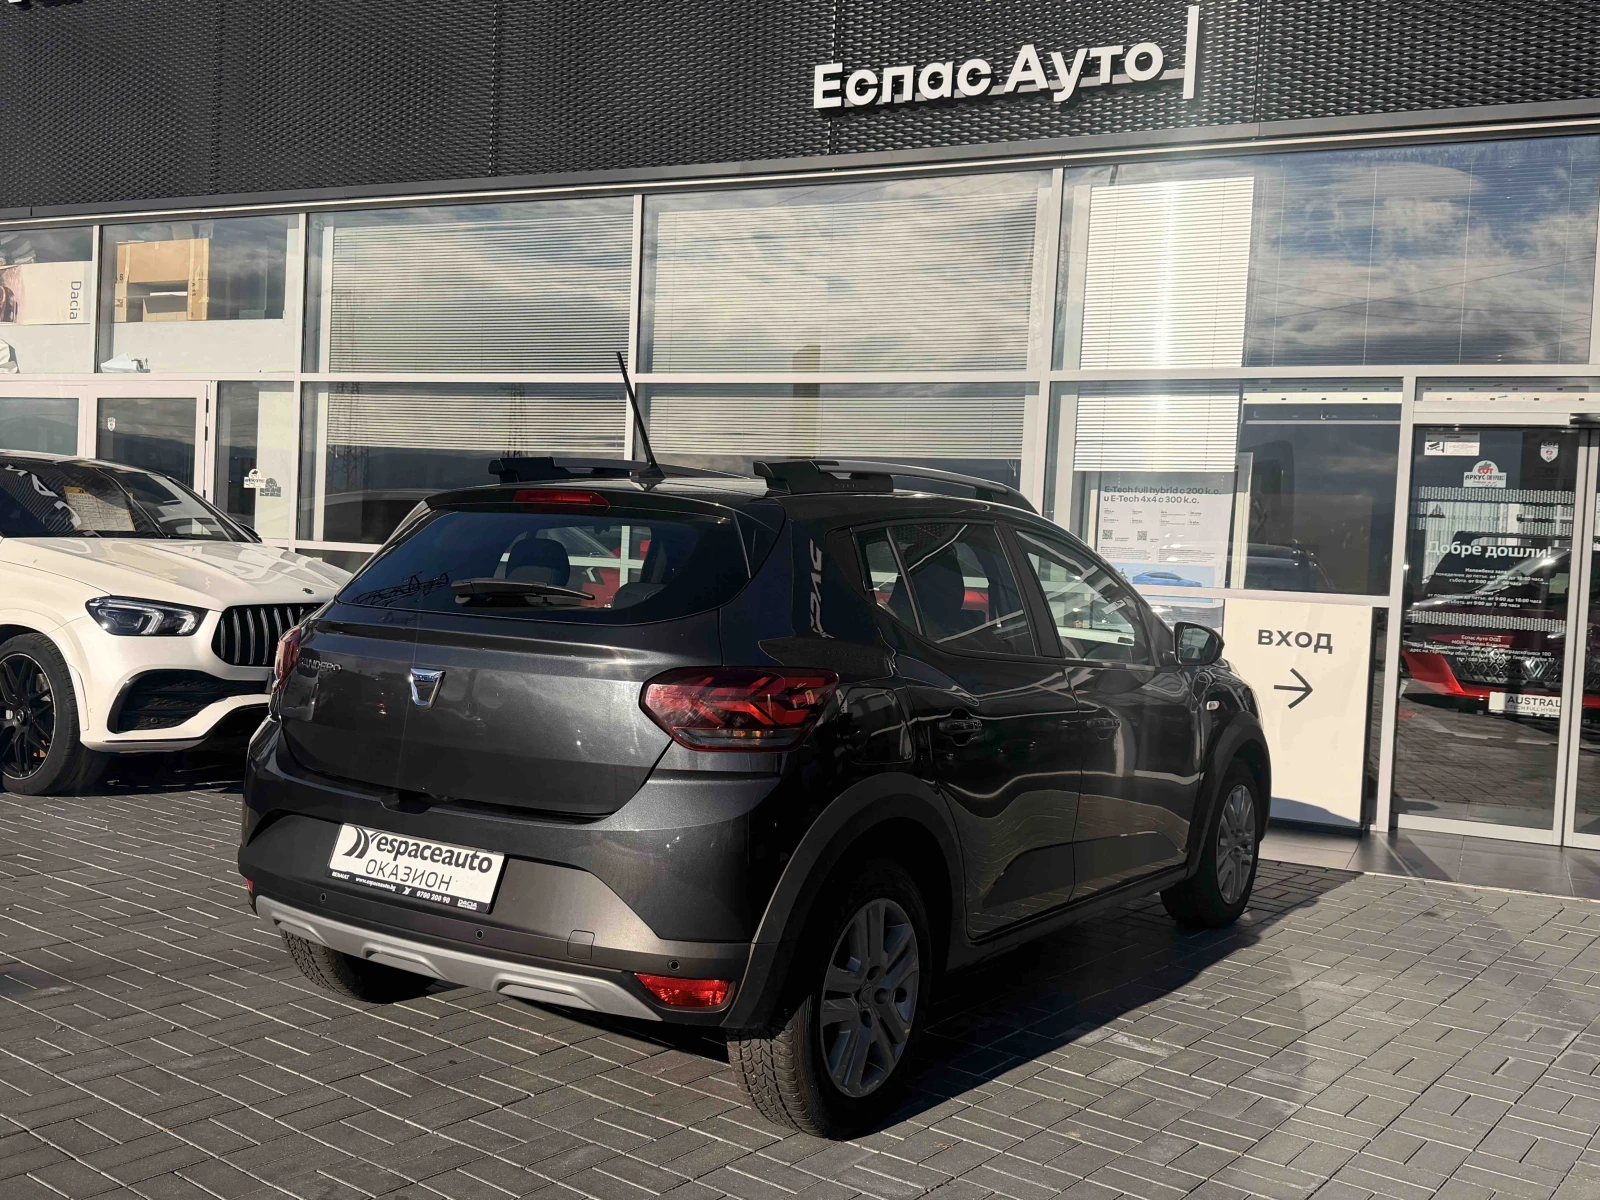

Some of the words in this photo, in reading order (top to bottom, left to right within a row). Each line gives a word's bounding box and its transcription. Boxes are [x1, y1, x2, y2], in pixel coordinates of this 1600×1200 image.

[814, 58, 992, 109] Еспас
[1004, 42, 1164, 102] Ауто
[69, 281, 82, 320] Dacia
[1104, 486, 1133, 494] E-Tech
[1134, 486, 1148, 494] full
[1149, 486, 1178, 495] hybrid
[1186, 487, 1204, 495] 200
[1110, 495, 1140, 503] E-Tech
[1140, 495, 1157, 503] 4x4
[1427, 541, 1482, 556] Добре
[1485, 545, 1552, 559] дошли!
[1257, 629, 1333, 654] ВХОД
[1507, 695, 1561, 708] AUSTRAL
[376, 835, 493, 874] espaceauto
[365, 858, 453, 892] ОКАЗИОН
[416, 890, 430, 899] 0700
[430, 893, 442, 902] 200
[442, 896, 451, 904] 90
[457, 899, 478, 909] DACIA
